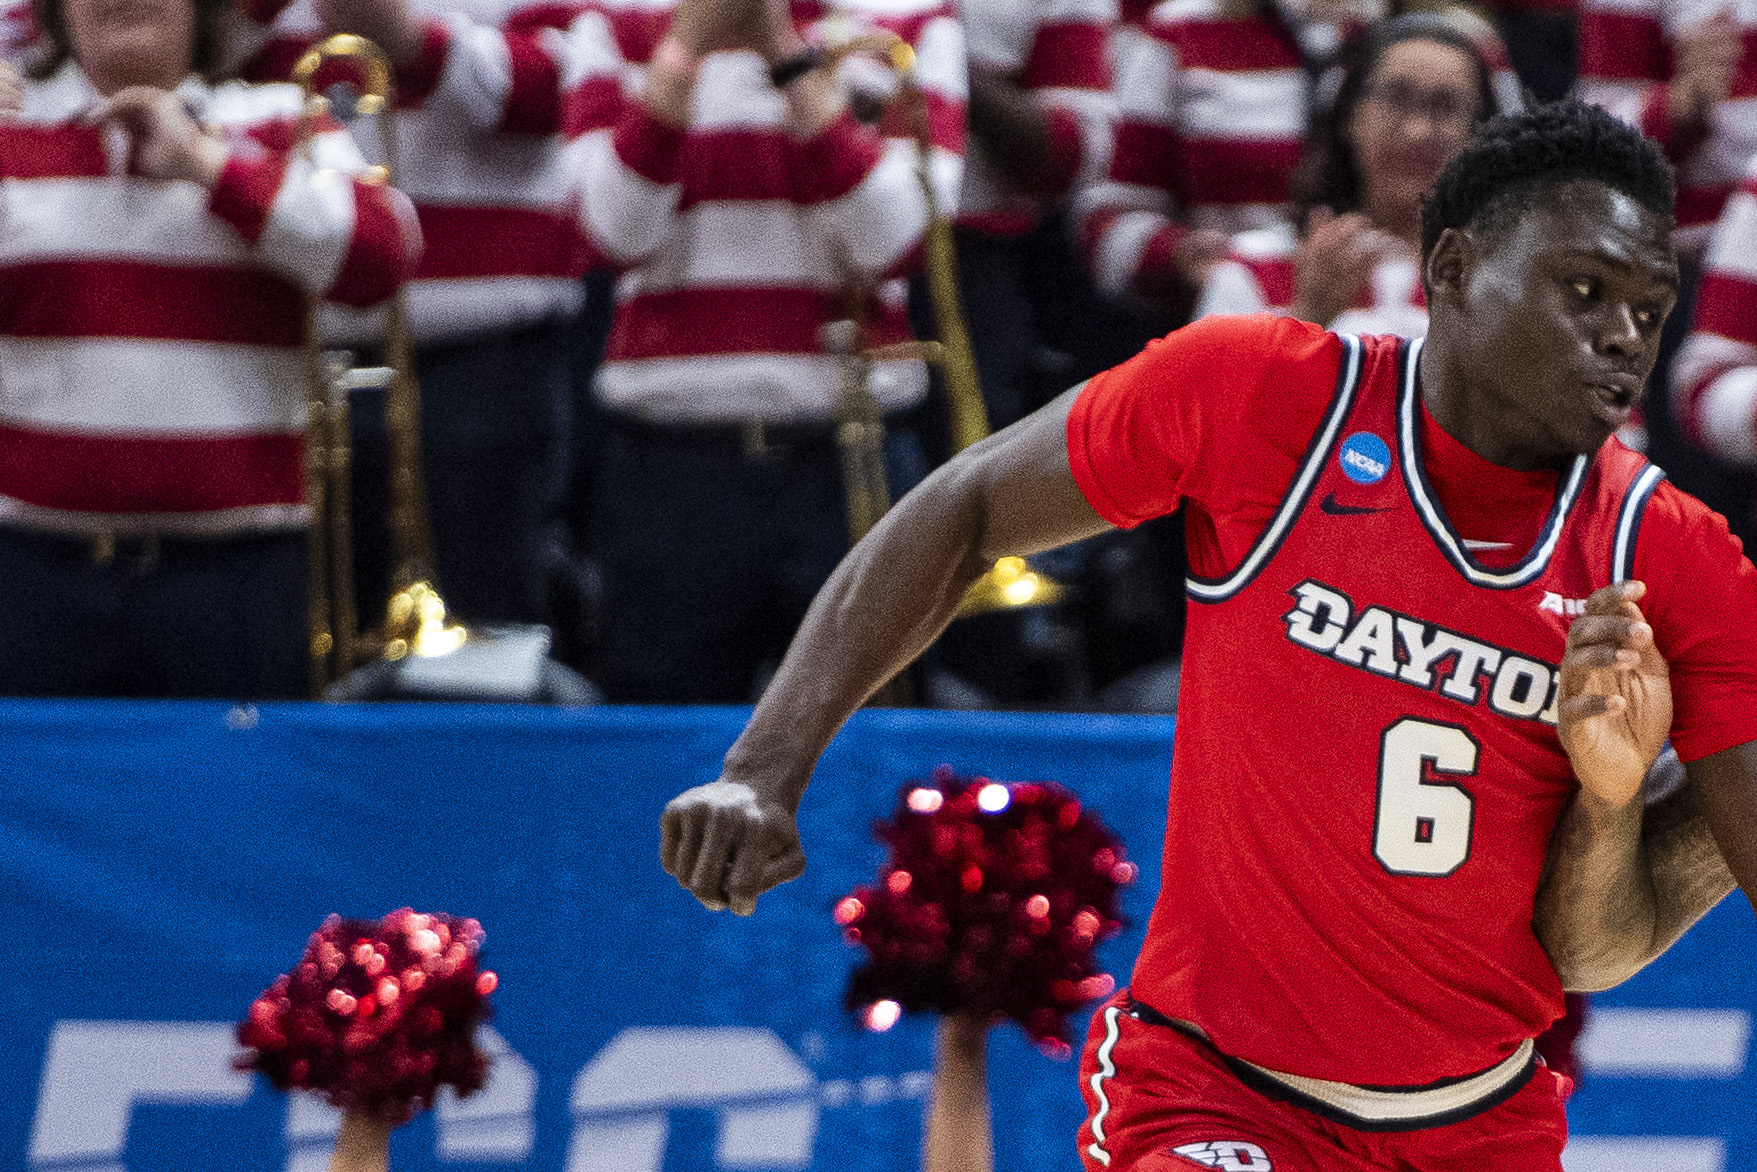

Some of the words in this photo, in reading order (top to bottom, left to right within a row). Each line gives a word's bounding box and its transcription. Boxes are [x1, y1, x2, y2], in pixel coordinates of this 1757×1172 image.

[1344, 448, 1384, 477] NCAA
[1285, 579, 1559, 724] DAYTO
[1374, 717, 1480, 877] 6
